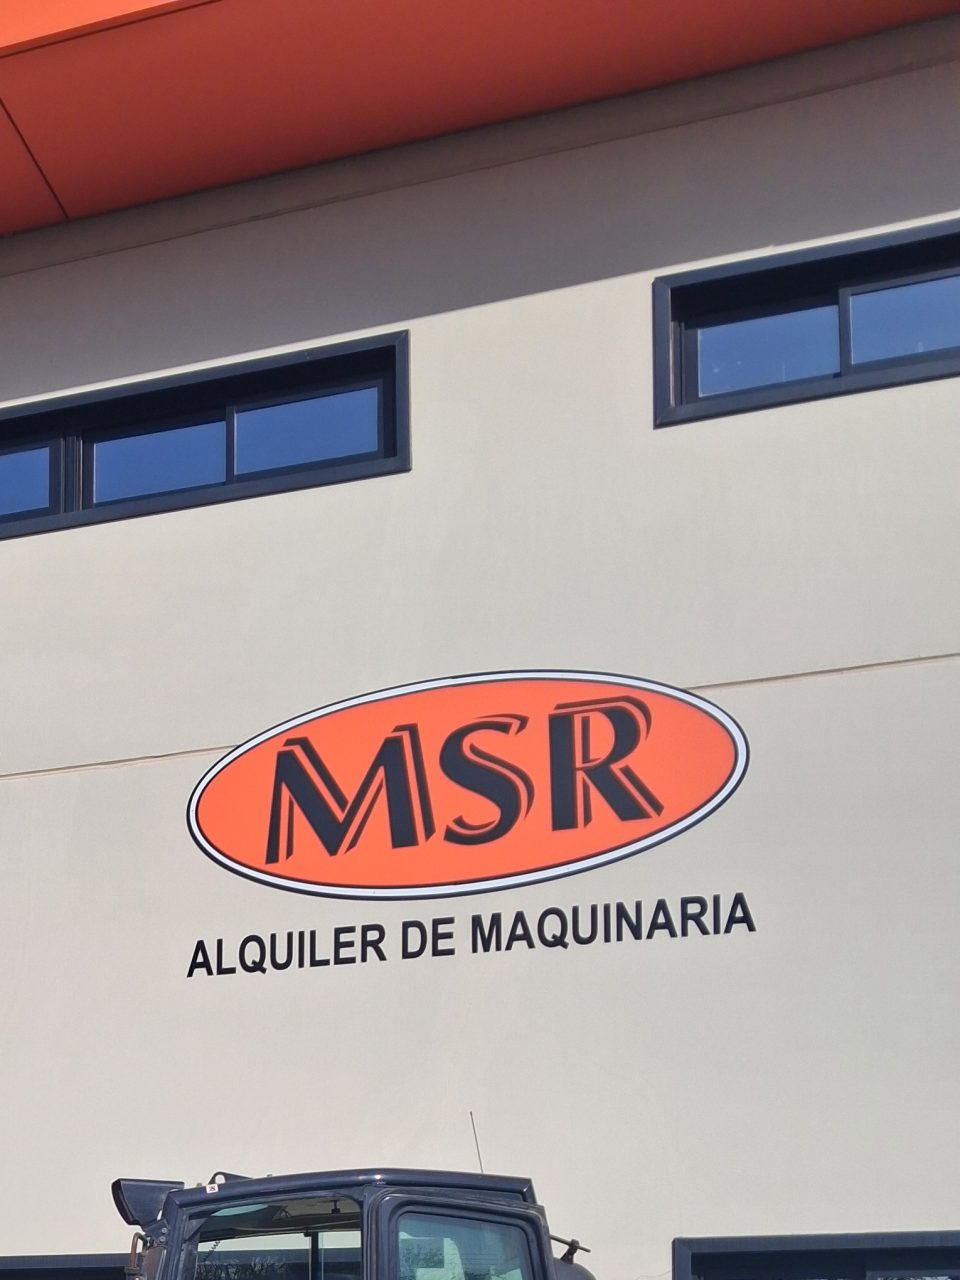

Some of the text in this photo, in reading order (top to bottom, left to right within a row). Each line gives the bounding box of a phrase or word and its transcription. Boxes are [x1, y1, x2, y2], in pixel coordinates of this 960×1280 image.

[265, 695, 664, 864] MSR
[187, 892, 757, 978] ALQUILER DE MAQUINARIA
